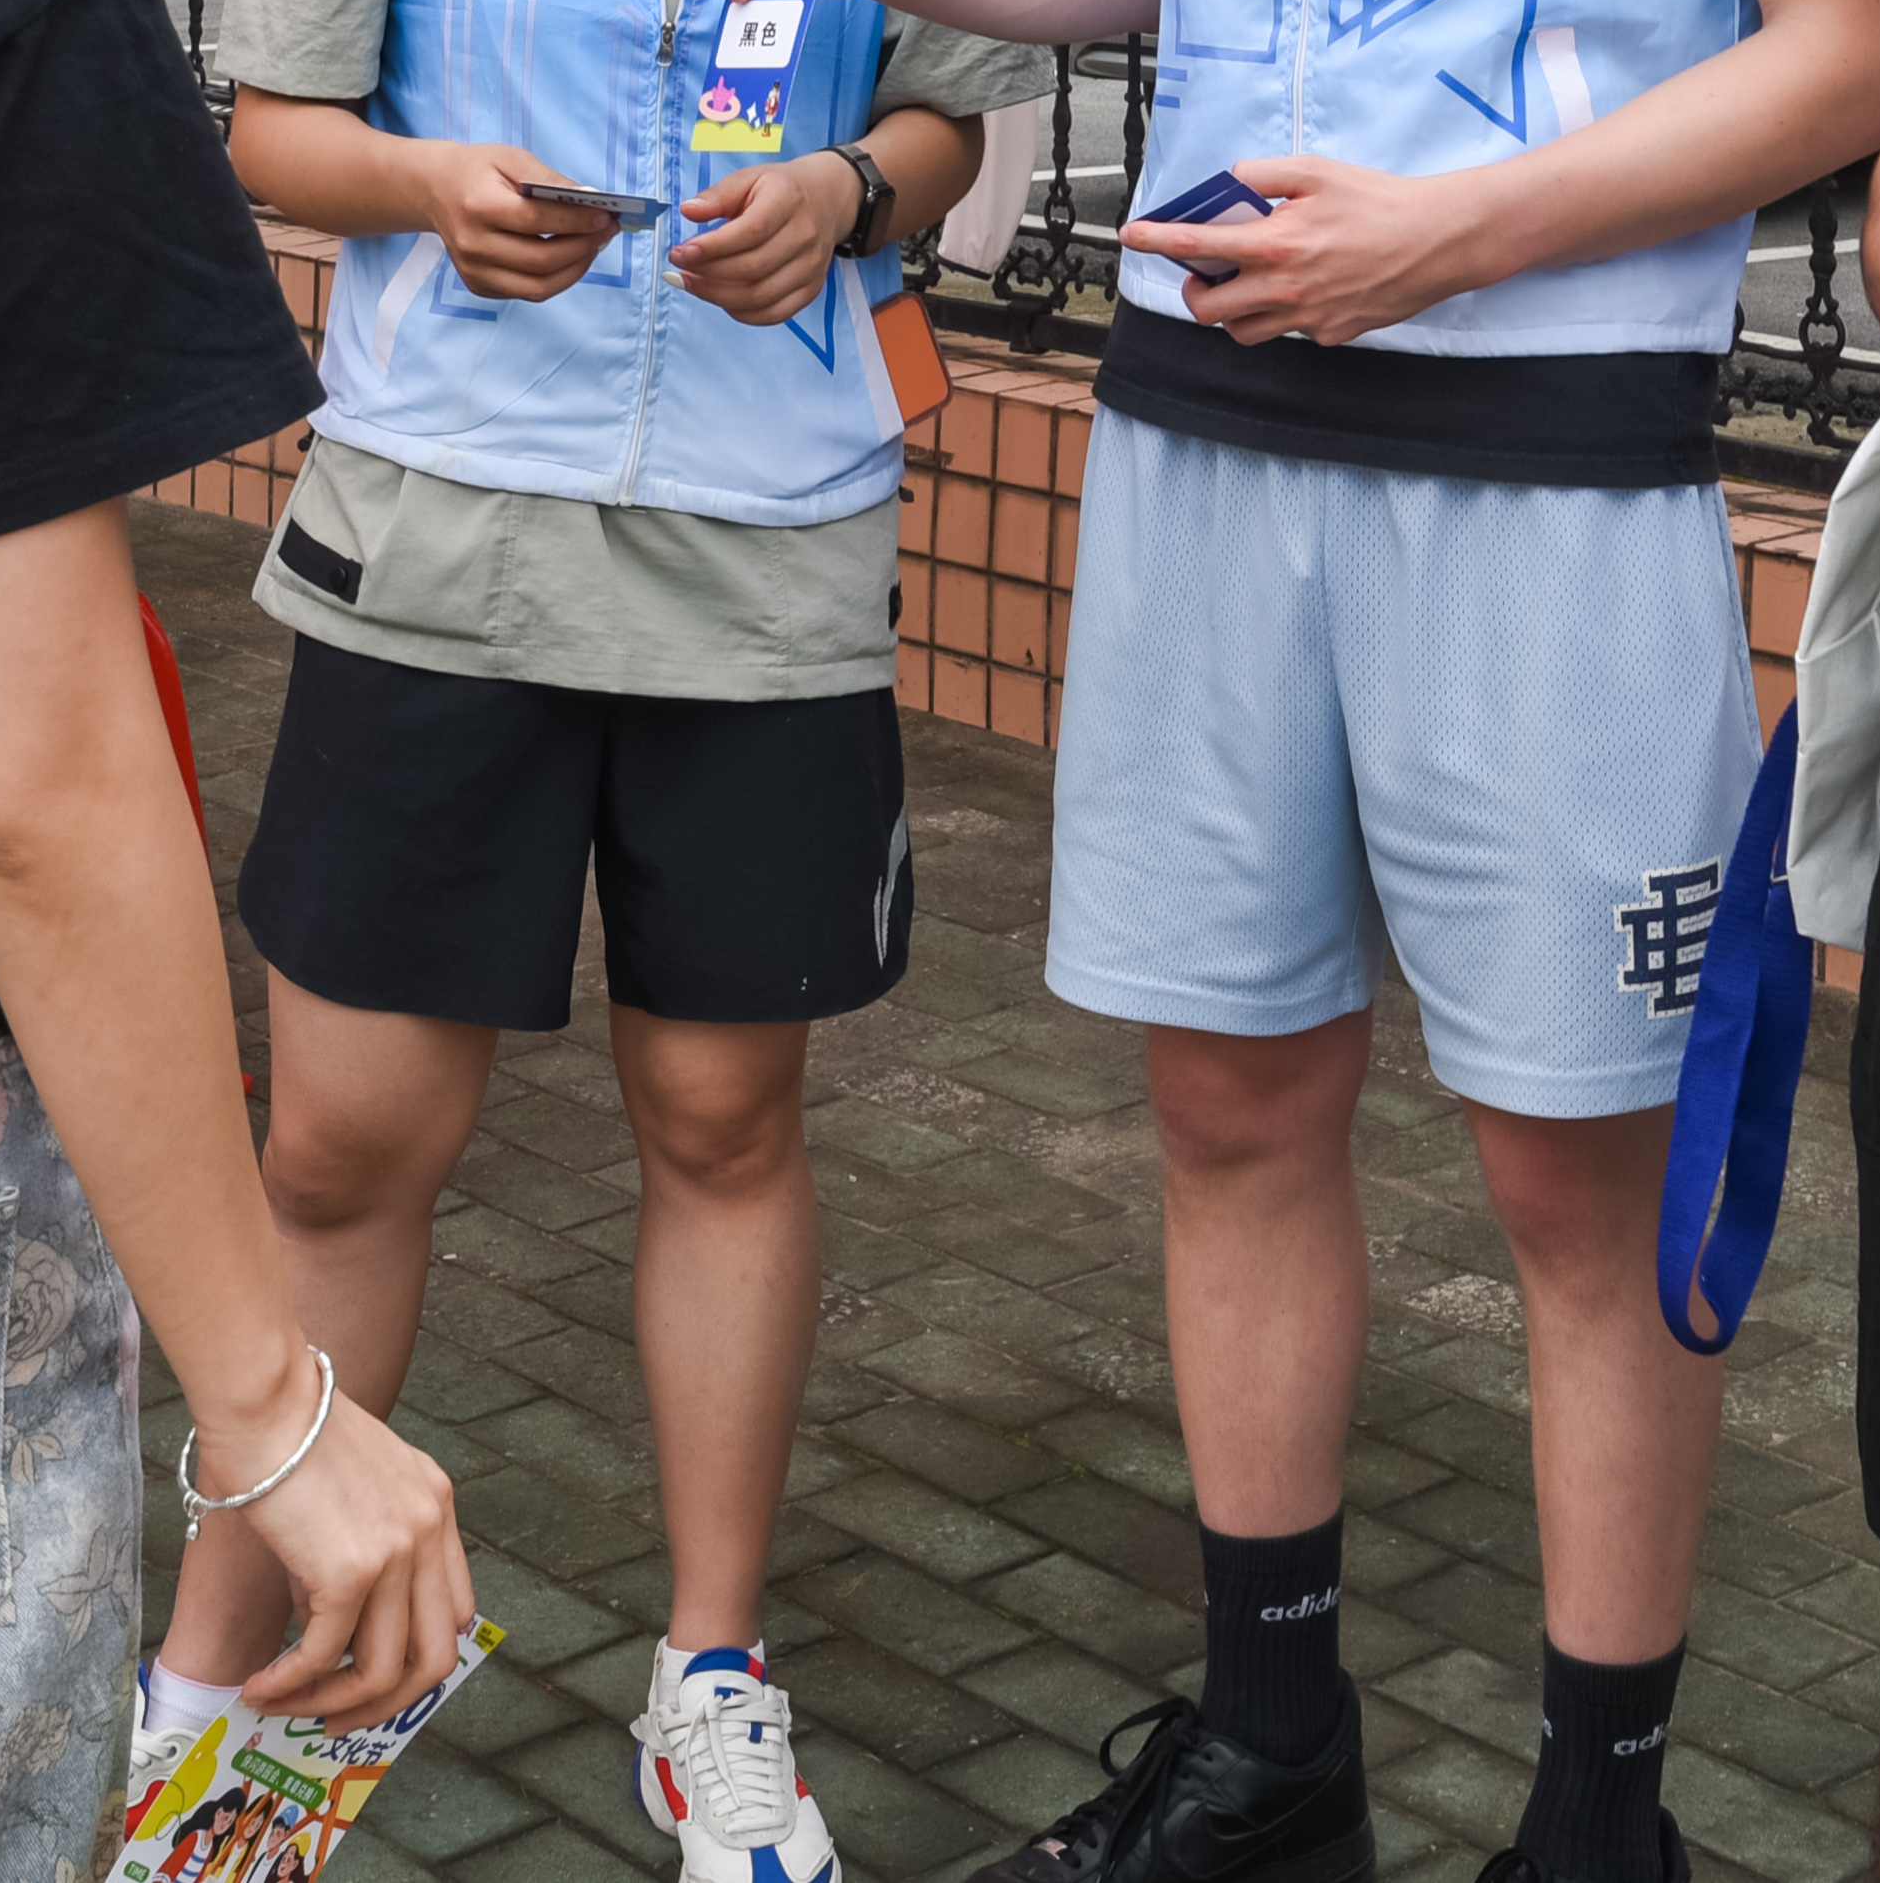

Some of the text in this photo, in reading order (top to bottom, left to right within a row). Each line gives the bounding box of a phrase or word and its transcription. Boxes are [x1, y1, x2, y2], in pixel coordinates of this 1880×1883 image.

[739, 21, 777, 47] 黑色
[319, 1736, 397, 1767] 文化节
